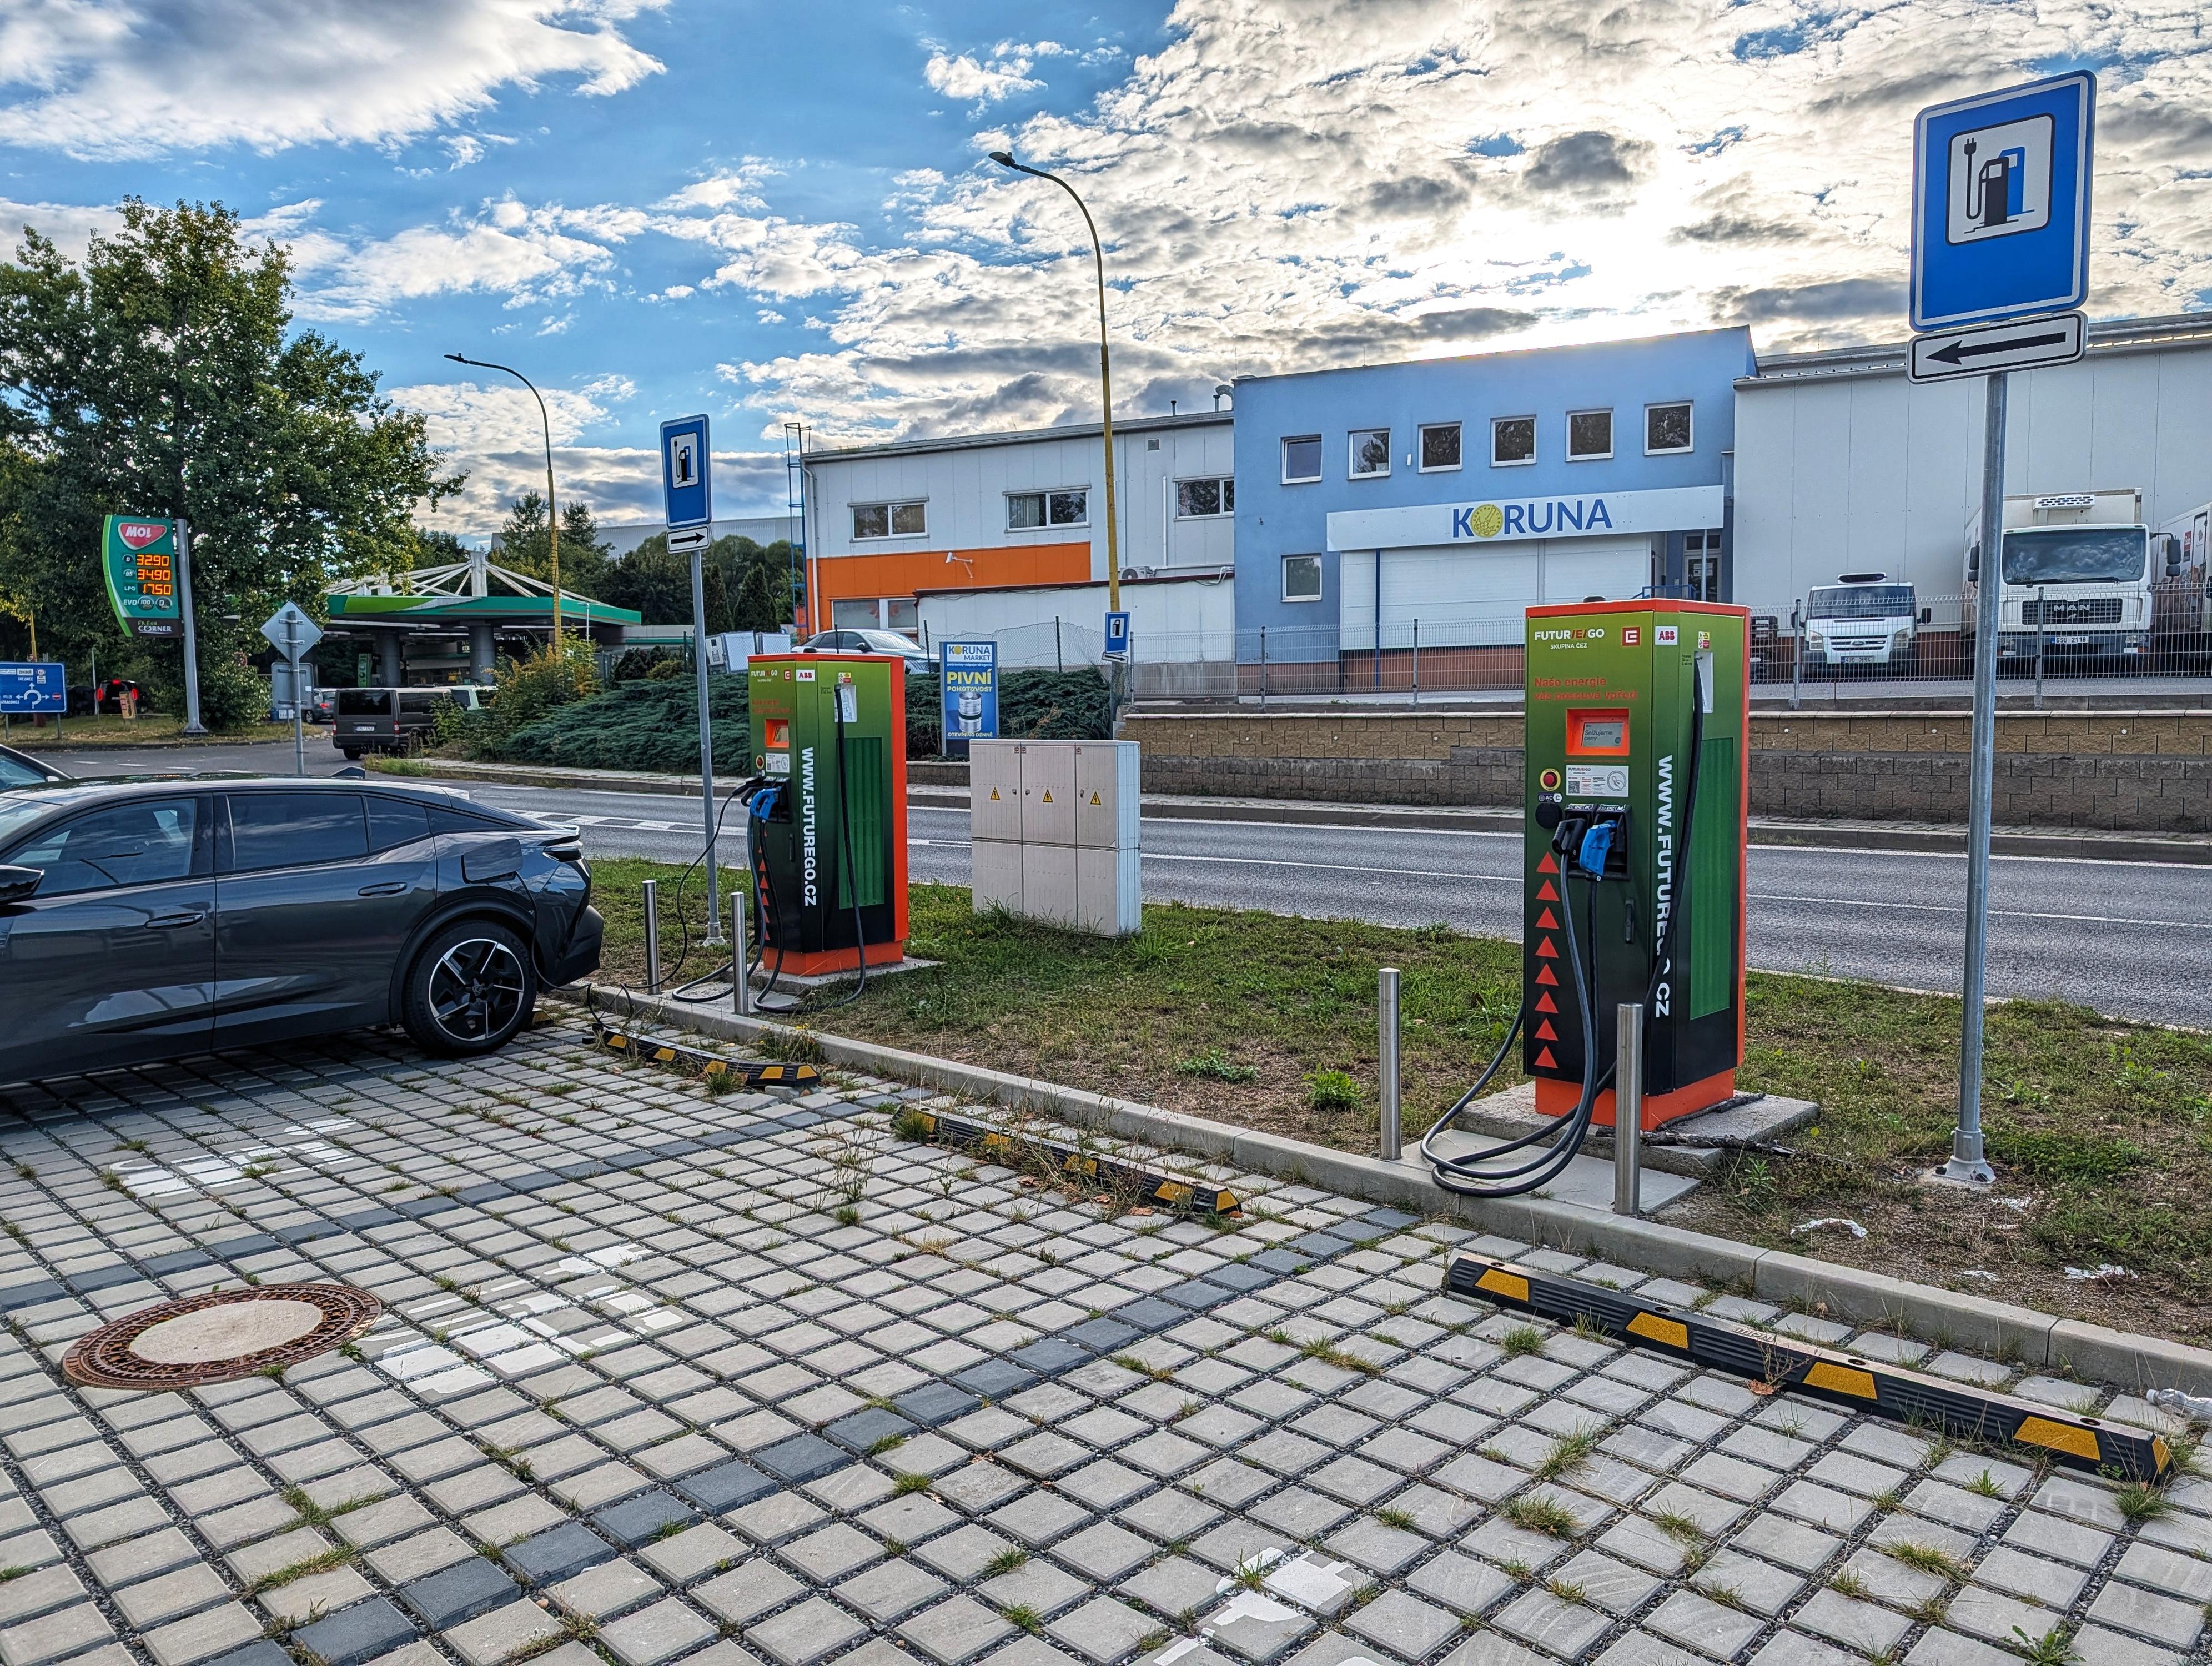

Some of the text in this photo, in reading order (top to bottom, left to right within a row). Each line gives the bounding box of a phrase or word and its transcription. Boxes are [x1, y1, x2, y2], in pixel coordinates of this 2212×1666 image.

[1452, 499, 1613, 538] KORUNA
[125, 526, 152, 538] MOL
[1534, 628, 1605, 641] FUTUR/E/GO
[1658, 630, 1675, 641] ABB
[948, 645, 991, 655] KORUNA
[947, 668, 992, 684] PIVNÍ
[1534, 675, 1606, 688] Naše energie
[802, 746, 817, 907] WWW.FUTUREGO.CZ
[1656, 755, 1673, 1017] WWW.FUTURECZ
